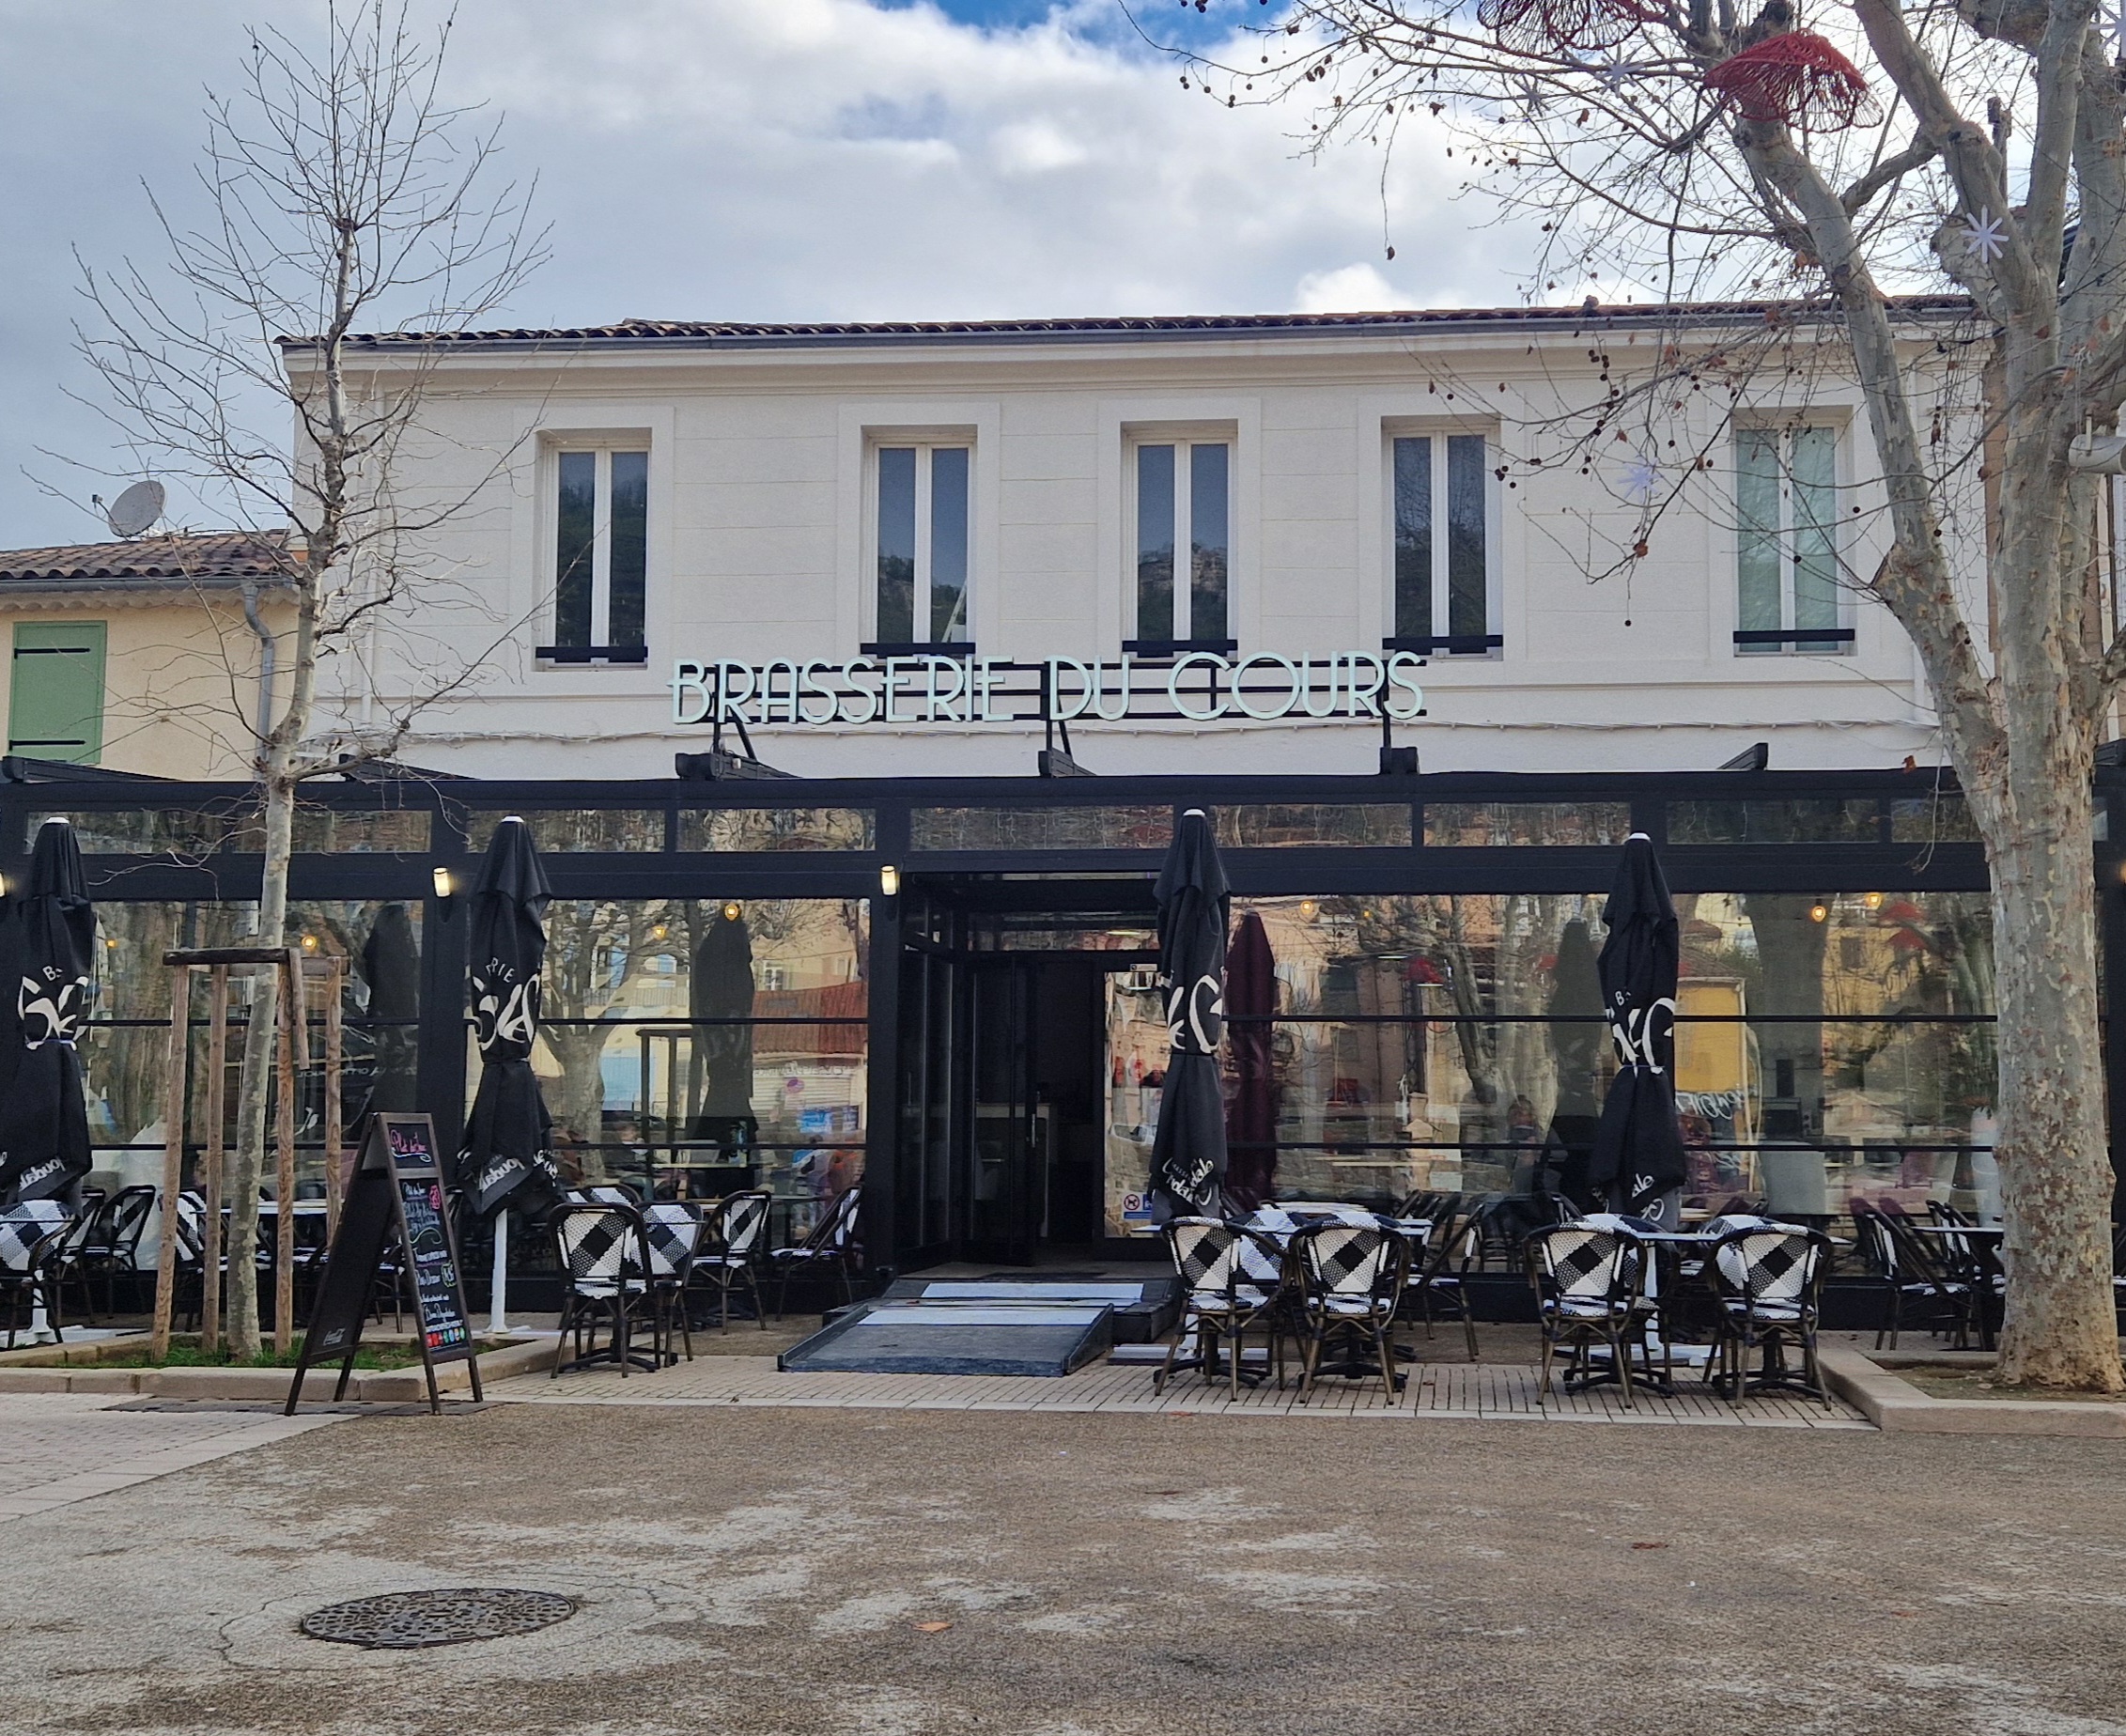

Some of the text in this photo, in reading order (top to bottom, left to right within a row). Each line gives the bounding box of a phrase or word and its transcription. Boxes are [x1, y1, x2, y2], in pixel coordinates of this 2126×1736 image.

[666, 650, 1425, 724] BRASSERIE DU COURS
